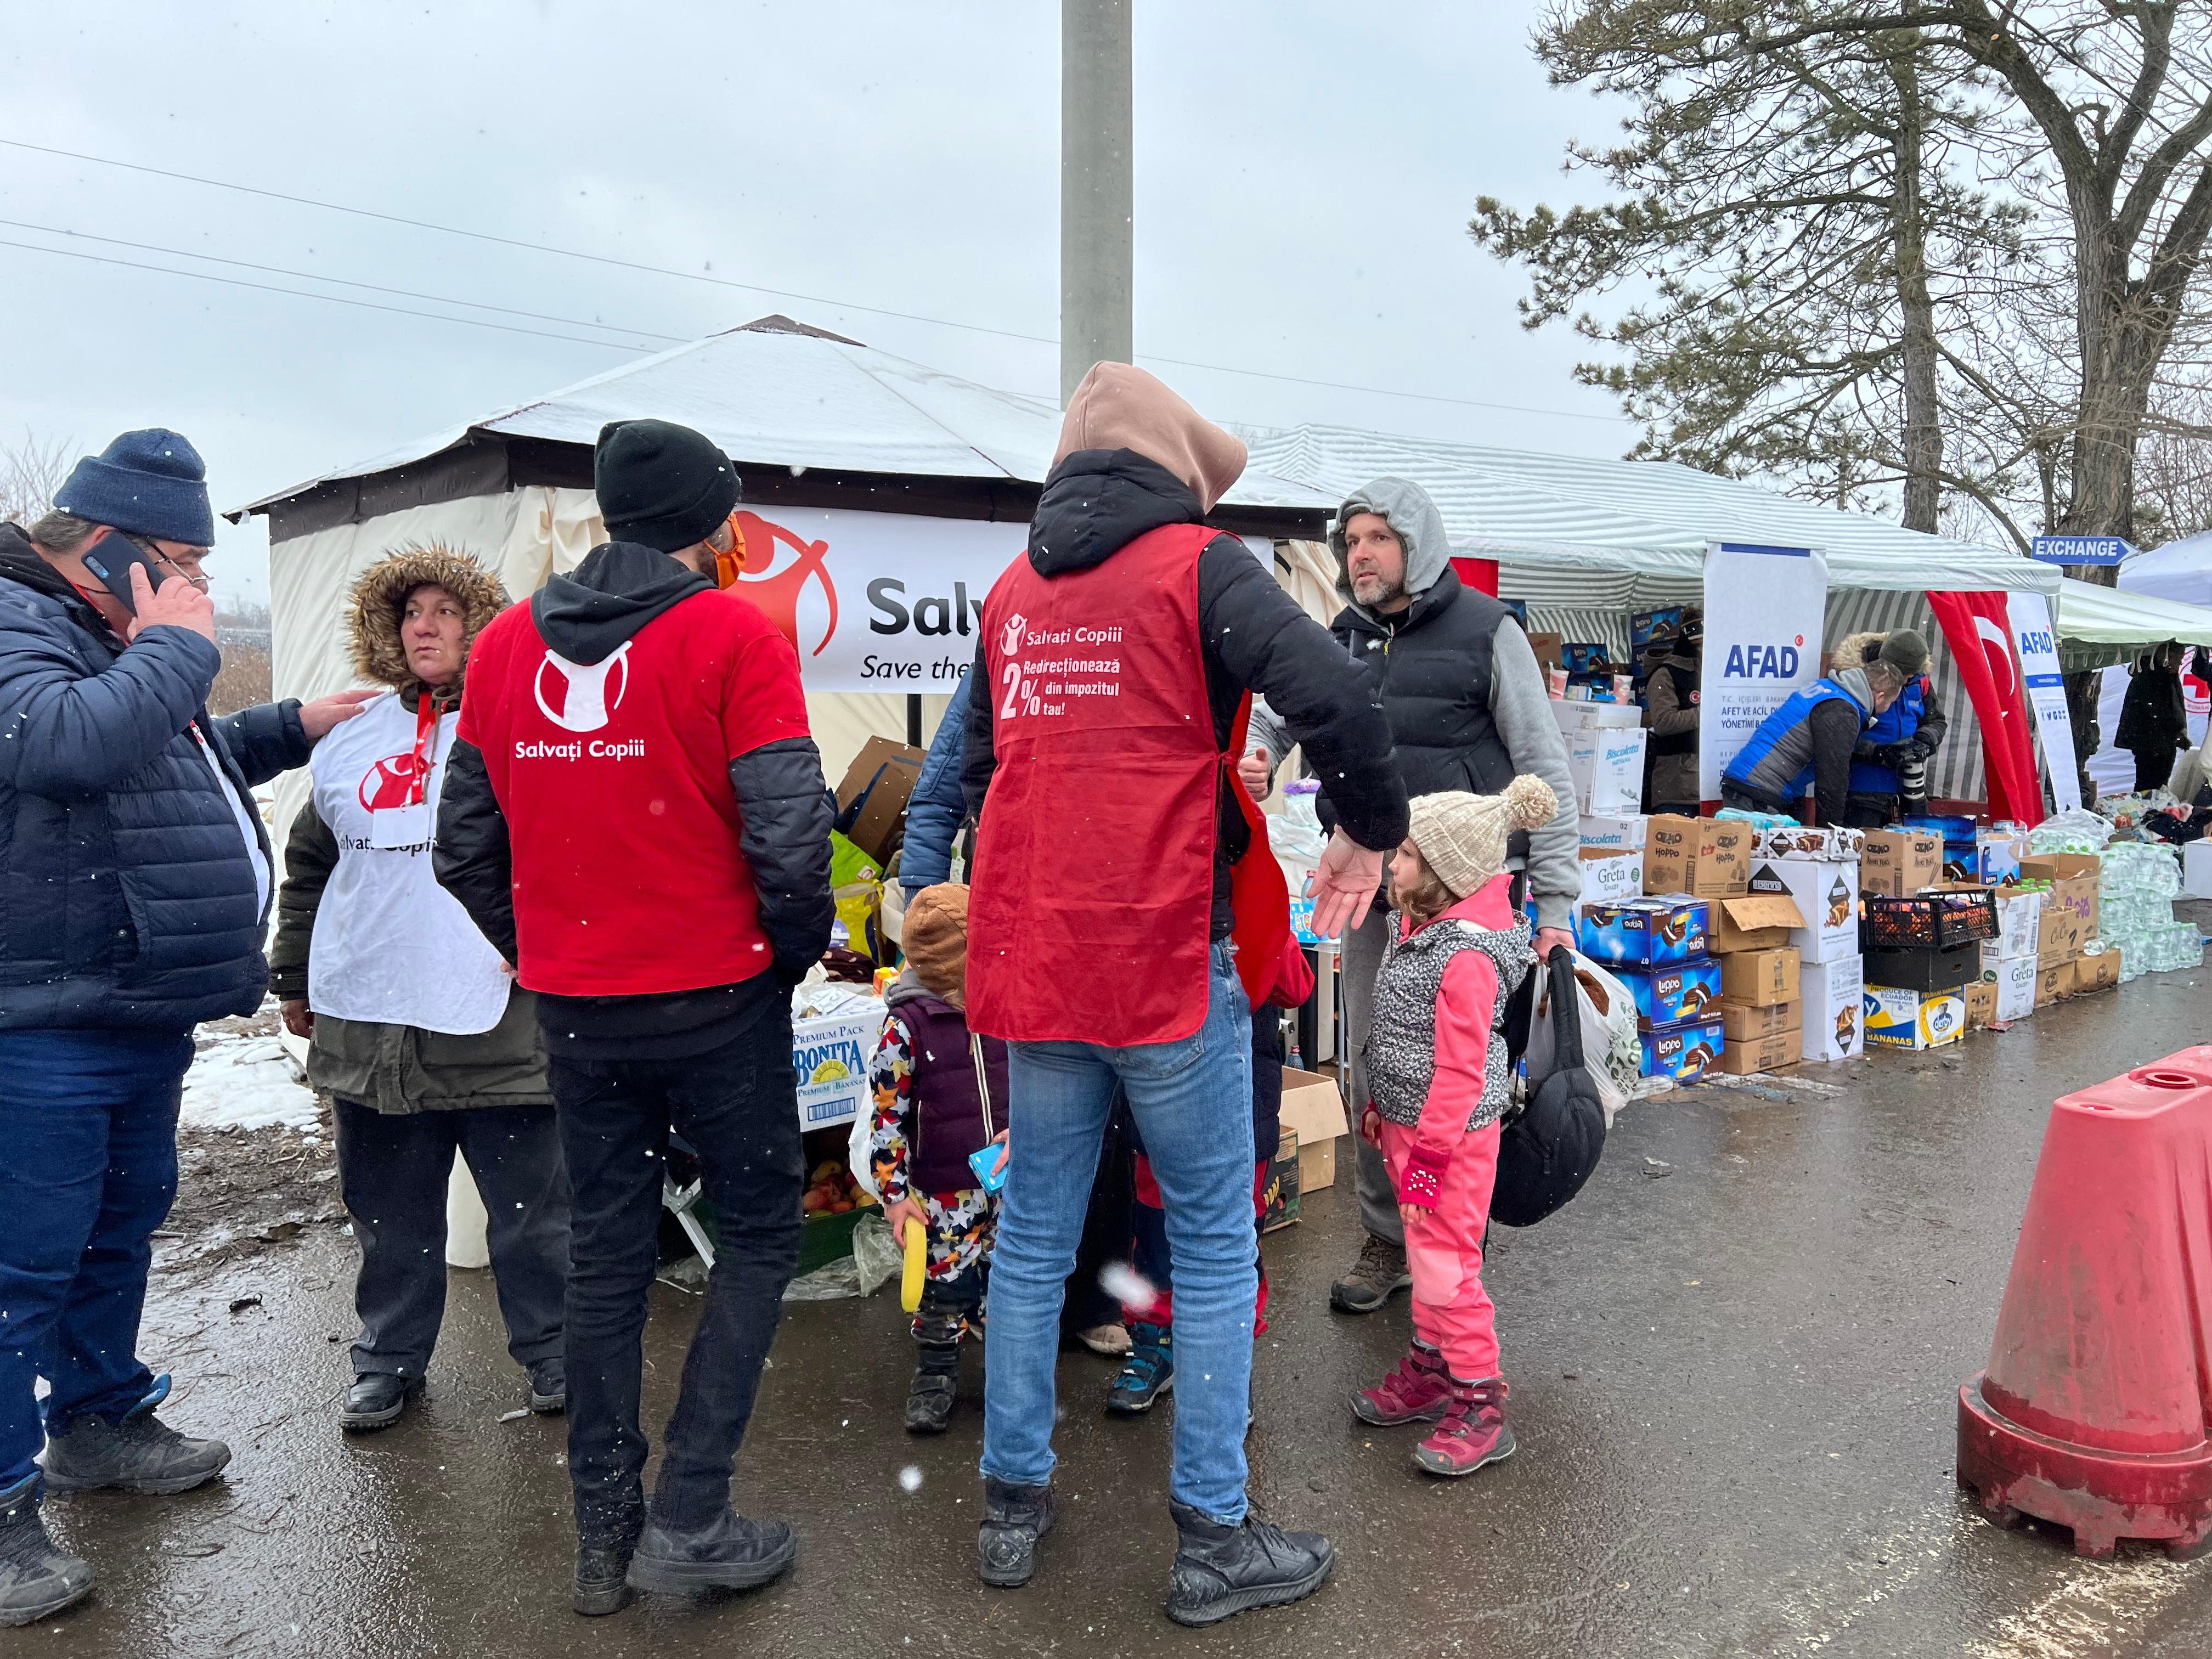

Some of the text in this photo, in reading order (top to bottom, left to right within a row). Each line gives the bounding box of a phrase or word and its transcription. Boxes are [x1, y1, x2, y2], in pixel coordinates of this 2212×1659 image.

[2035, 540, 2118, 556] EXCHANGE
[1026, 627, 1122, 646] Salvați Copiii
[2022, 631, 2052, 654] AFAD
[860, 655, 971, 679] Save the
[1023, 658, 1120, 678] Redirecționează
[1724, 645, 1798, 679] AFAD
[1000, 662, 1041, 720] 2%
[1045, 681, 1120, 698] din impozitul
[1043, 702, 1065, 716] tau!
[1722, 707, 1741, 715] AFET
[1742, 707, 1751, 715] VE
[1753, 705, 1768, 715] ACİL
[1722, 718, 1754, 729] YÖNETİMİ
[515, 739, 645, 762] Salvați Copiii
[1605, 743, 1639, 760] Biscolata
[1598, 868, 1625, 883] Greta
[1624, 919, 1643, 930] Luppo
[1689, 936, 1705, 951] Luppo
[2012, 968, 2033, 981] Greta
[1658, 979, 1680, 994] Luppo
[1870, 986, 1902, 995] PRODUCE
[1881, 993, 1913, 1001] ECUADOR
[1934, 1014, 1953, 1029] derby
[793, 1024, 865, 1045] PREMIUM PACK
[1866, 1034, 1912, 1046] BANANAS
[1658, 1039, 1681, 1054] Luppo
[793, 1040, 866, 1087] BONITA
[835, 1079, 866, 1090] BANANAS
